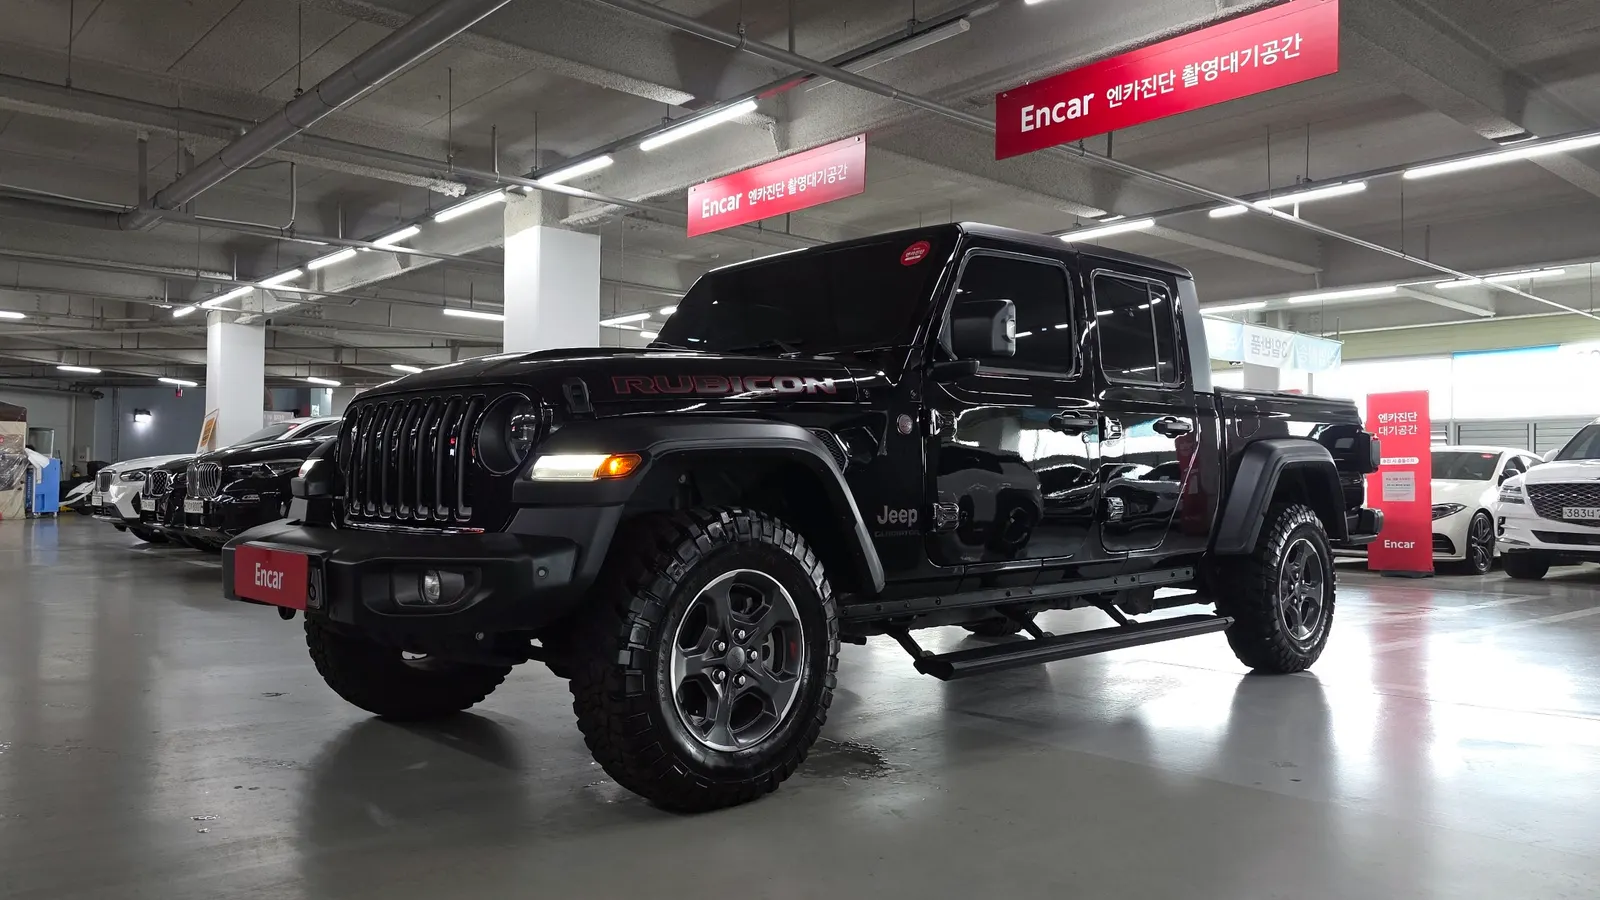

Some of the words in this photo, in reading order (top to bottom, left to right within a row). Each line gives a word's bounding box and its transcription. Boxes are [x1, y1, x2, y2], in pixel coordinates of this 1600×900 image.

[1020, 90, 1095, 133] Encar
[1106, 69, 1177, 109] 엔카진단
[1181, 33, 1303, 86] 촬영대기공간
[701, 191, 743, 219] Encar
[748, 180, 785, 206] 엔카진단
[787, 163, 848, 195] 촬영대기공간
[610, 375, 838, 395] RUBICON
[1377, 411, 1418, 424] 엔카진단
[1378, 424, 1418, 436] 대기공간
[876, 505, 918, 528] Jeep
[1567, 508, 1595, 518] 383너
[1383, 539, 1416, 550] Encar
[254, 561, 285, 591] Encar
